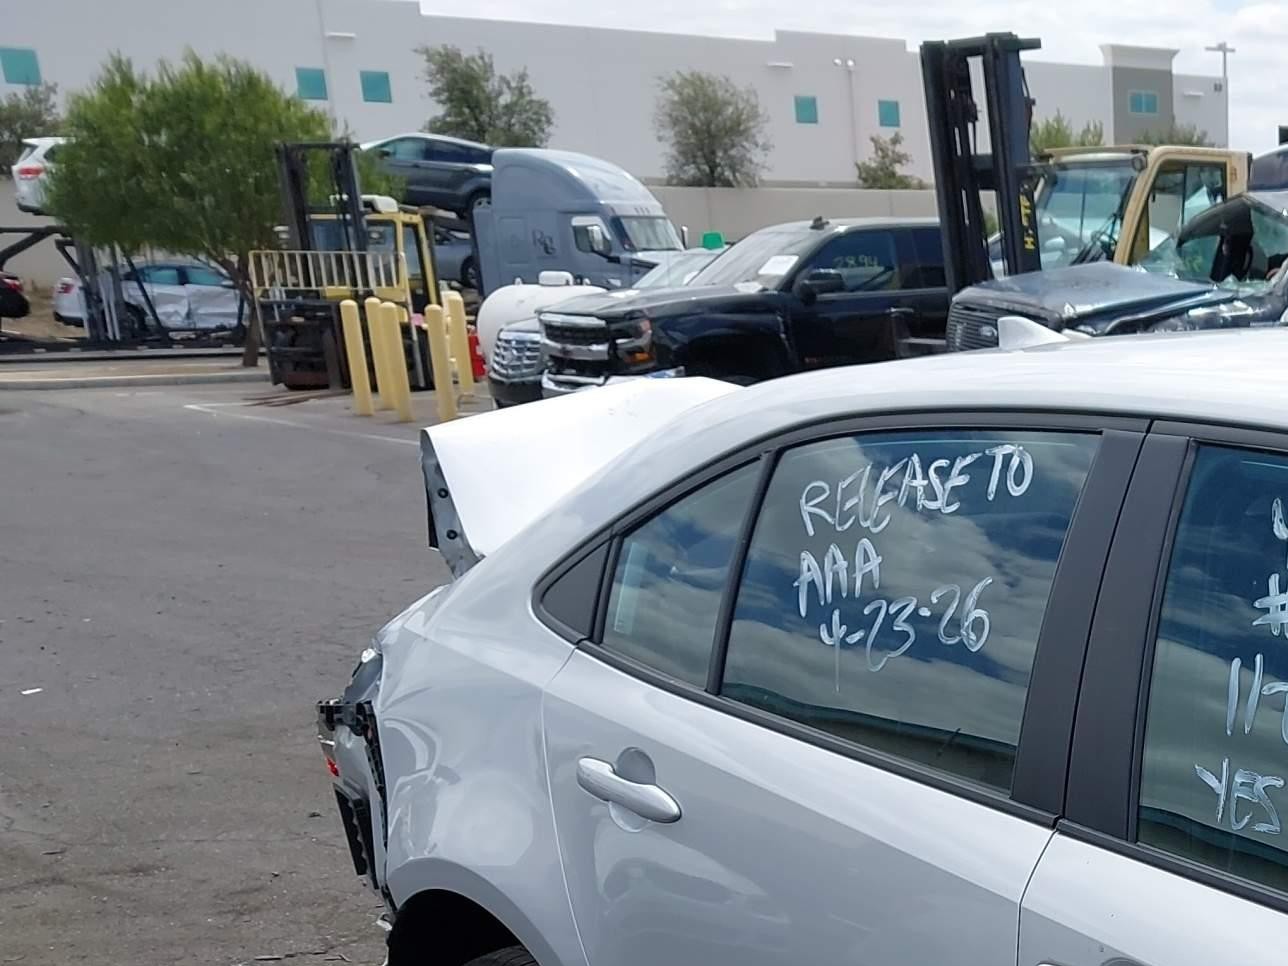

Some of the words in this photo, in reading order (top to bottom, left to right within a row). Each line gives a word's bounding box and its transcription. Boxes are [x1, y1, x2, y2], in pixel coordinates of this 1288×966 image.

[799, 452, 982, 537] RELEASE
[985, 443, 1034, 501] TO
[793, 537, 882, 617] AAA
[1194, 757, 1285, 834] YES
